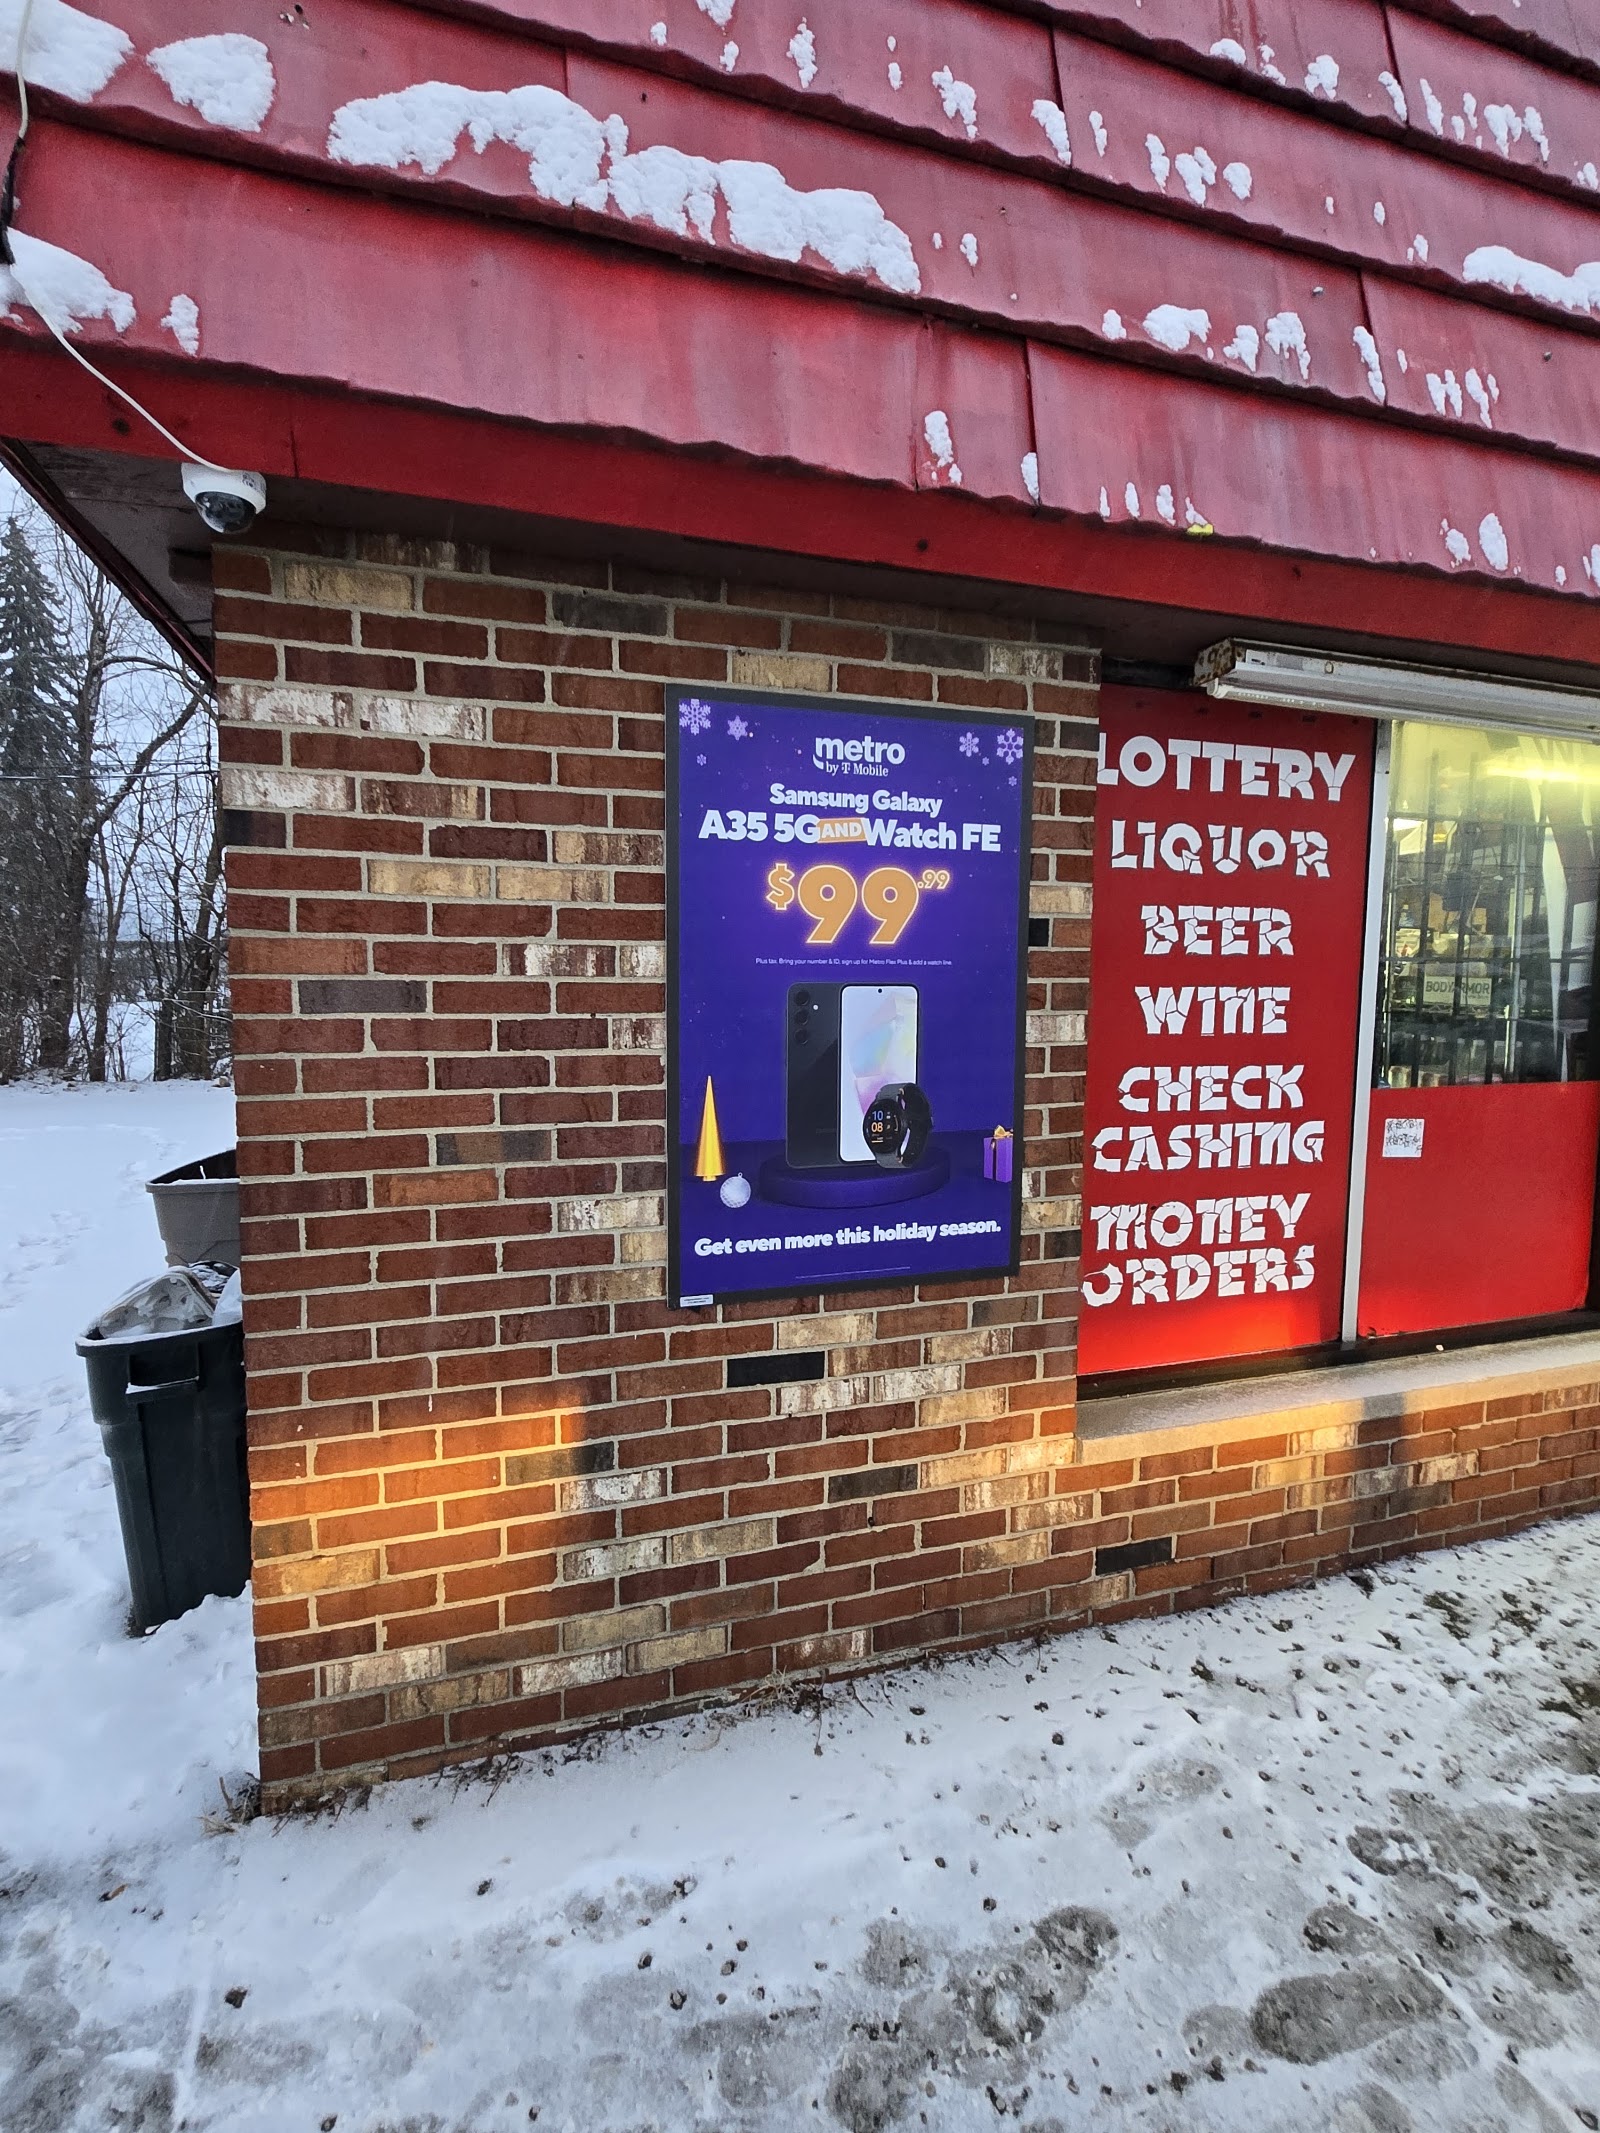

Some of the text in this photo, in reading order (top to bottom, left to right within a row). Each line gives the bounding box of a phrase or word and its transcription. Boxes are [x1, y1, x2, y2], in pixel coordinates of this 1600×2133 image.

[815, 736, 905, 764] metro
[826, 761, 839, 777] by
[853, 763, 889, 777] Mobile
[1097, 732, 1356, 802] LOTTERY
[769, 783, 943, 818] Samsung Galaxy
[698, 810, 1001, 852] A35 5G AND Watch FE
[1111, 819, 1330, 878] LIQUOR
[1140, 905, 1294, 956] BEER
[778, 958, 794, 966] Bring
[1135, 986, 1291, 1036] WINE
[1117, 1064, 1304, 1113] CHECK
[871, 1122, 884, 1132] 08
[872, 1110, 884, 1120] 10
[1091, 1120, 1325, 1173] CASHING
[694, 1218, 1002, 1257] Get even more this holiday season.
[1090, 1192, 1311, 1252] MONEY
[1081, 1244, 1315, 1307] ORDERS
